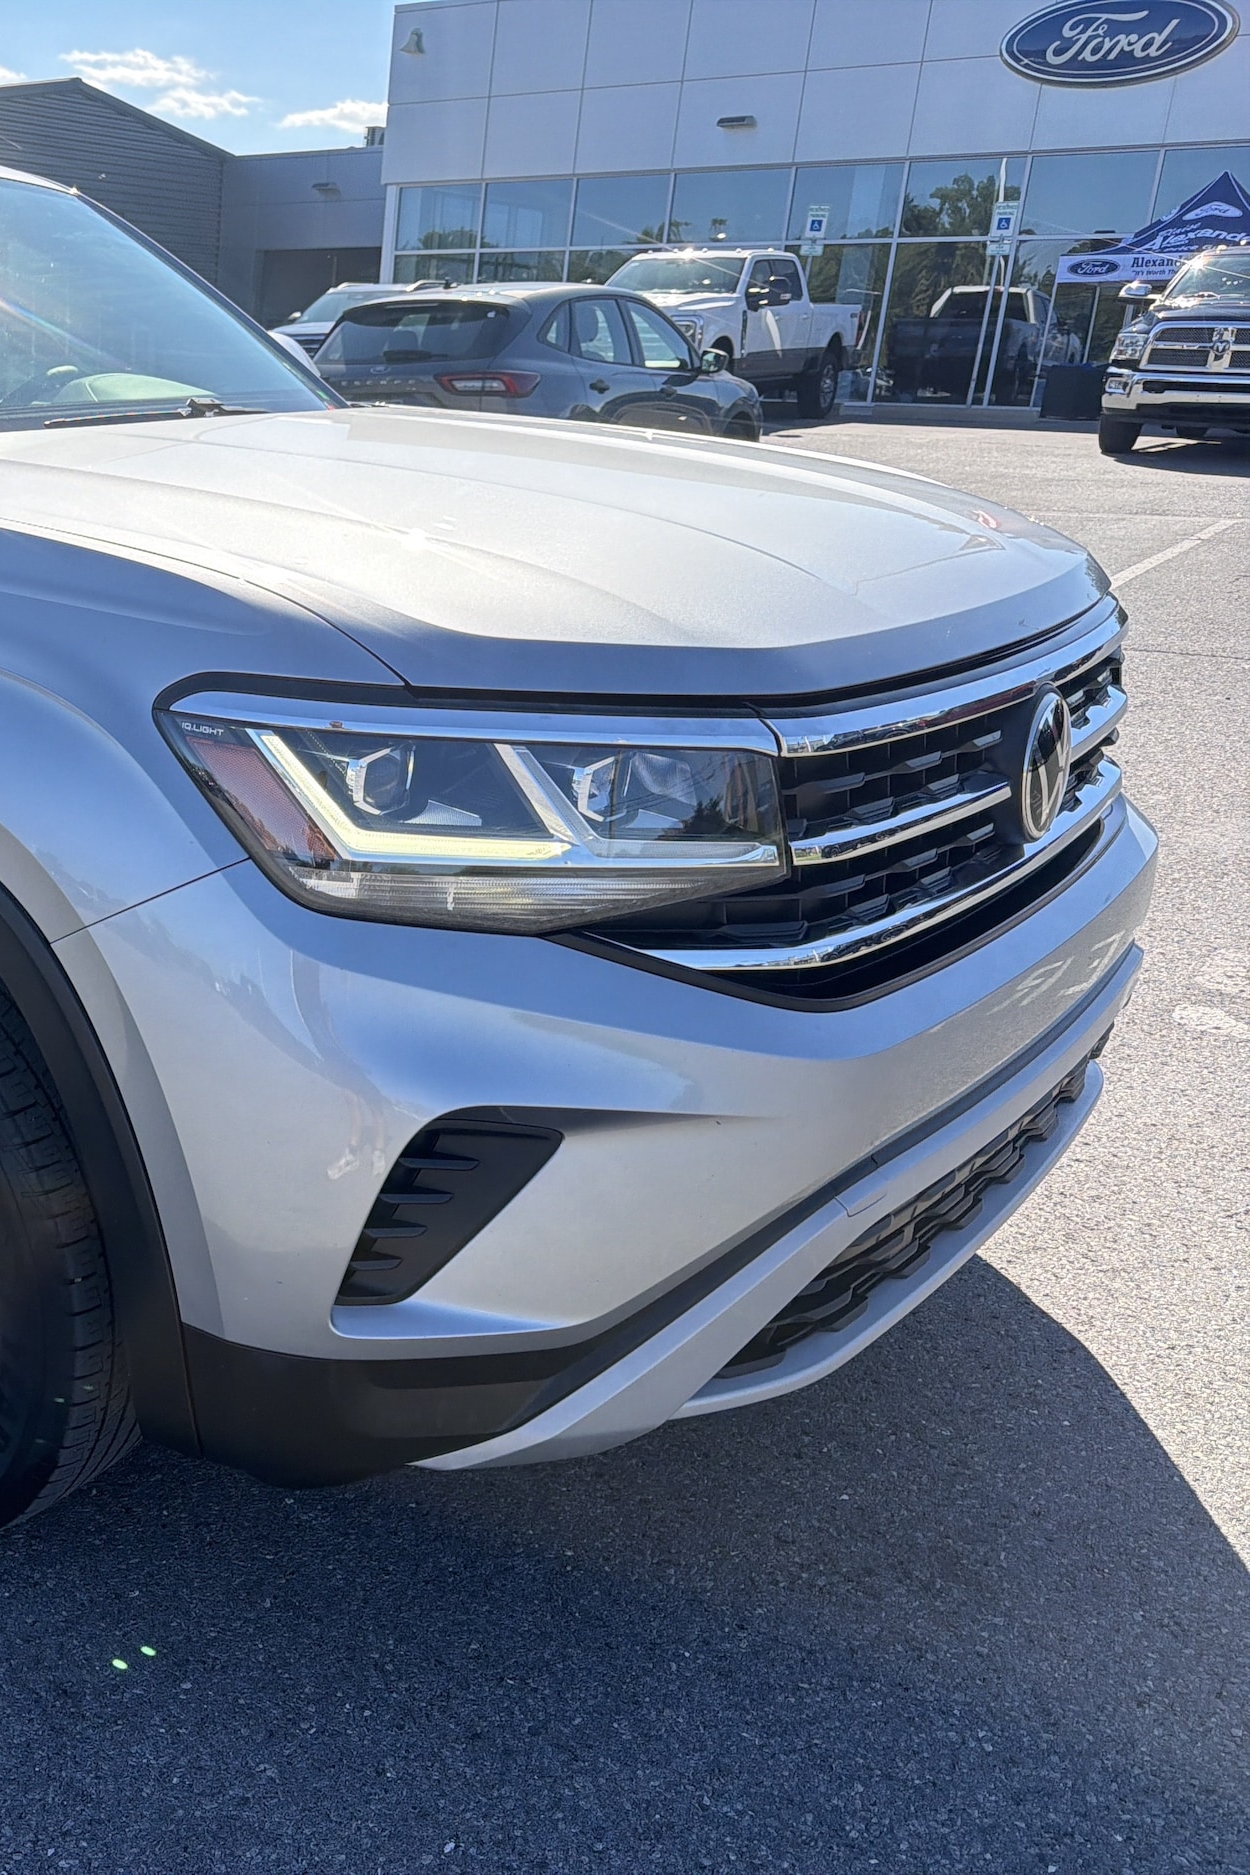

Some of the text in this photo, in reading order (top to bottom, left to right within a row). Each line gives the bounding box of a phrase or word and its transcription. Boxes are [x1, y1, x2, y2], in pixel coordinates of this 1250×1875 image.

[1046, 10, 1181, 65] Ford
[1077, 261, 1110, 274] Ford
[181, 722, 224, 736] IQ.LIGHT
